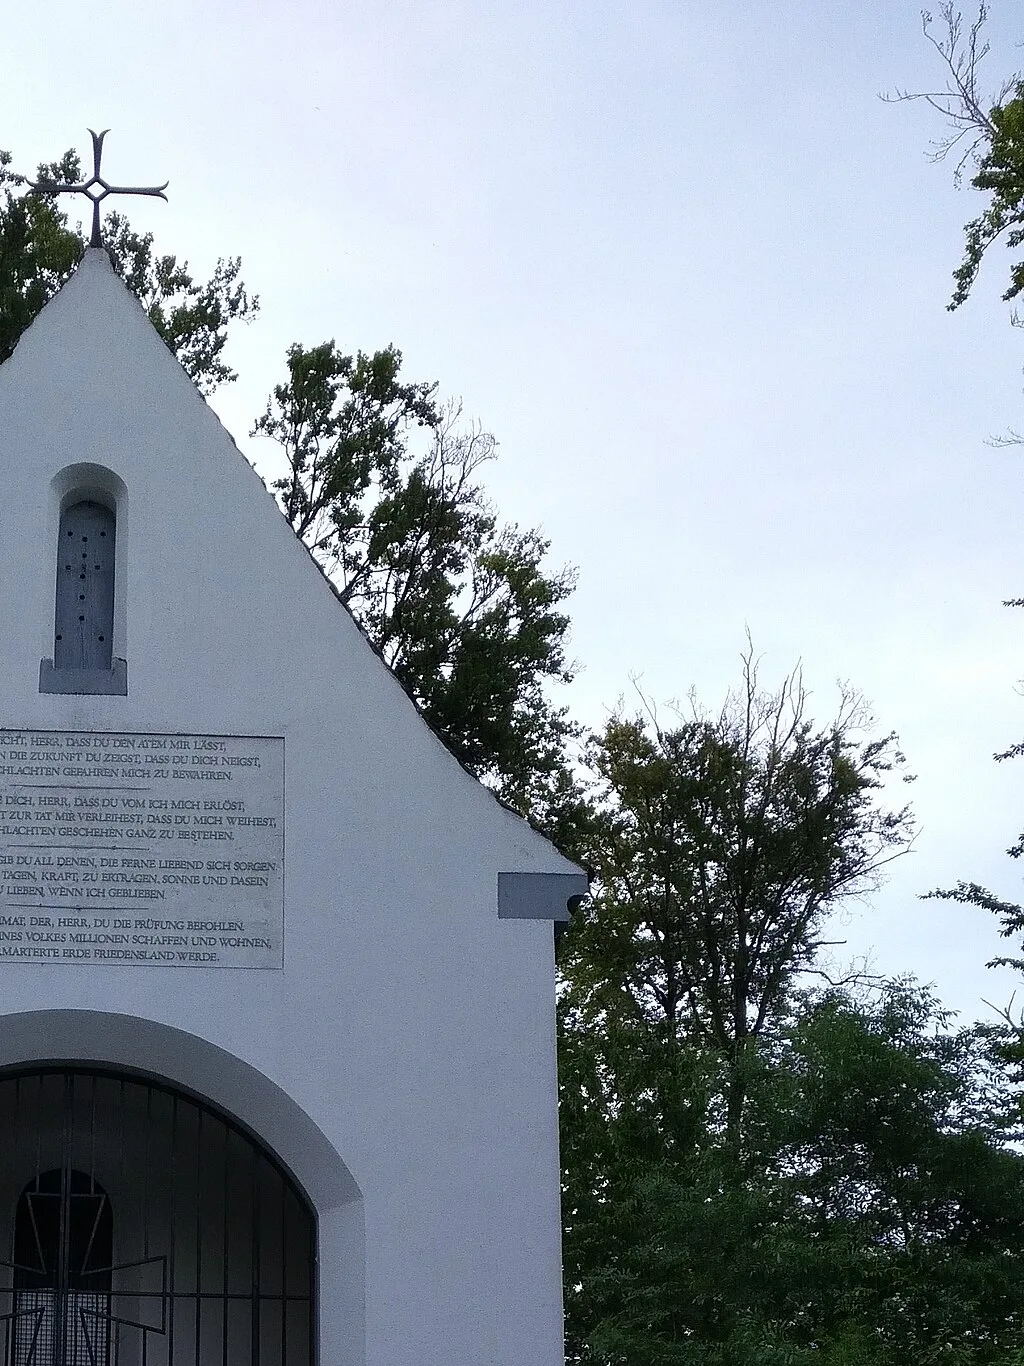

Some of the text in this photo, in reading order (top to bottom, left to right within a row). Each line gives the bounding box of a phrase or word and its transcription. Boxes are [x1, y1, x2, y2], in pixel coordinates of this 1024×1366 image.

[31, 736, 62, 748] HERR,
[66, 737, 90, 747] DASS
[94, 737, 109, 748] DU
[113, 738, 135, 748] DEN
[169, 739, 190, 750] MIR
[10, 750, 27, 760] DIE
[30, 751, 82, 762] ZUKUNFT
[86, 752, 104, 762] DU
[103, 753, 141, 765] ZEIGST,
[145, 754, 169, 764] DASS
[172, 755, 190, 765] DU
[190, 755, 218, 766] DICH
[222, 756, 260, 768] NEIGST,
[63, 767, 118, 778] GEFAHREN
[122, 768, 151, 778] MICH
[154, 769, 169, 779] ZU
[172, 770, 232, 781] BEWAHREN.
[6, 795, 35, 807] DICH,
[38, 796, 70, 808] HERR,
[74, 797, 99, 807] DASS
[102, 798, 118, 808] DU
[122, 798, 145, 808] VOM
[149, 799, 168, 809] ICH
[171, 799, 200, 810] MICH
[204, 799, 245, 812] ERLÖST,
[9, 810, 32, 820] ZUR
[34, 811, 52, 821] TAT
[55, 811, 76, 821] MIR
[78, 812, 143, 824] VERLEIHEST,
[146, 814, 172, 824] DASS
[174, 814, 190, 824] DU
[194, 815, 222, 825] MICH
[227, 816, 276, 828] WEIHEST,
[58, 826, 123, 838] GESCHEHEN
[126, 828, 156, 839] GANZ
[158, 829, 174, 839] ZU
[16, 855, 35, 865] DU
[33, 855, 54, 866] ALL
[57, 856, 97, 868] DENEN,
[100, 857, 118, 868] DIE
[121, 858, 156, 869] FERNE
[159, 859, 204, 870] LIEBEND
[206, 860, 230, 871] SICH
[2, 870, 37, 882] TAGEN,
[42, 871, 78, 883] KRAFT,
[82, 872, 98, 882] ZU
[160, 874, 200, 885] SONNE
[203, 875, 228, 885] UND
[230, 876, 268, 886] DASEIN
[48, 886, 83, 897] WENN
[86, 887, 105, 898] ICH
[30, 916, 54, 928] DER,
[58, 917, 90, 929] HERR,
[94, 918, 110, 928] DU
[113, 918, 131, 929] DIE
[134, 917, 184, 930] PRÜFUNG
[26, 931, 66, 942] VOLKES
[69, 932, 130, 944] MILLIONEN
[130, 934, 188, 946] SCHAFFEN
[191, 936, 217, 946] UND
[219, 936, 271, 949] WOHNEN,
[62, 948, 90, 958] ERDE
[94, 948, 176, 960] FRIEDENSLAND
[174, 950, 219, 962] WERDE.
